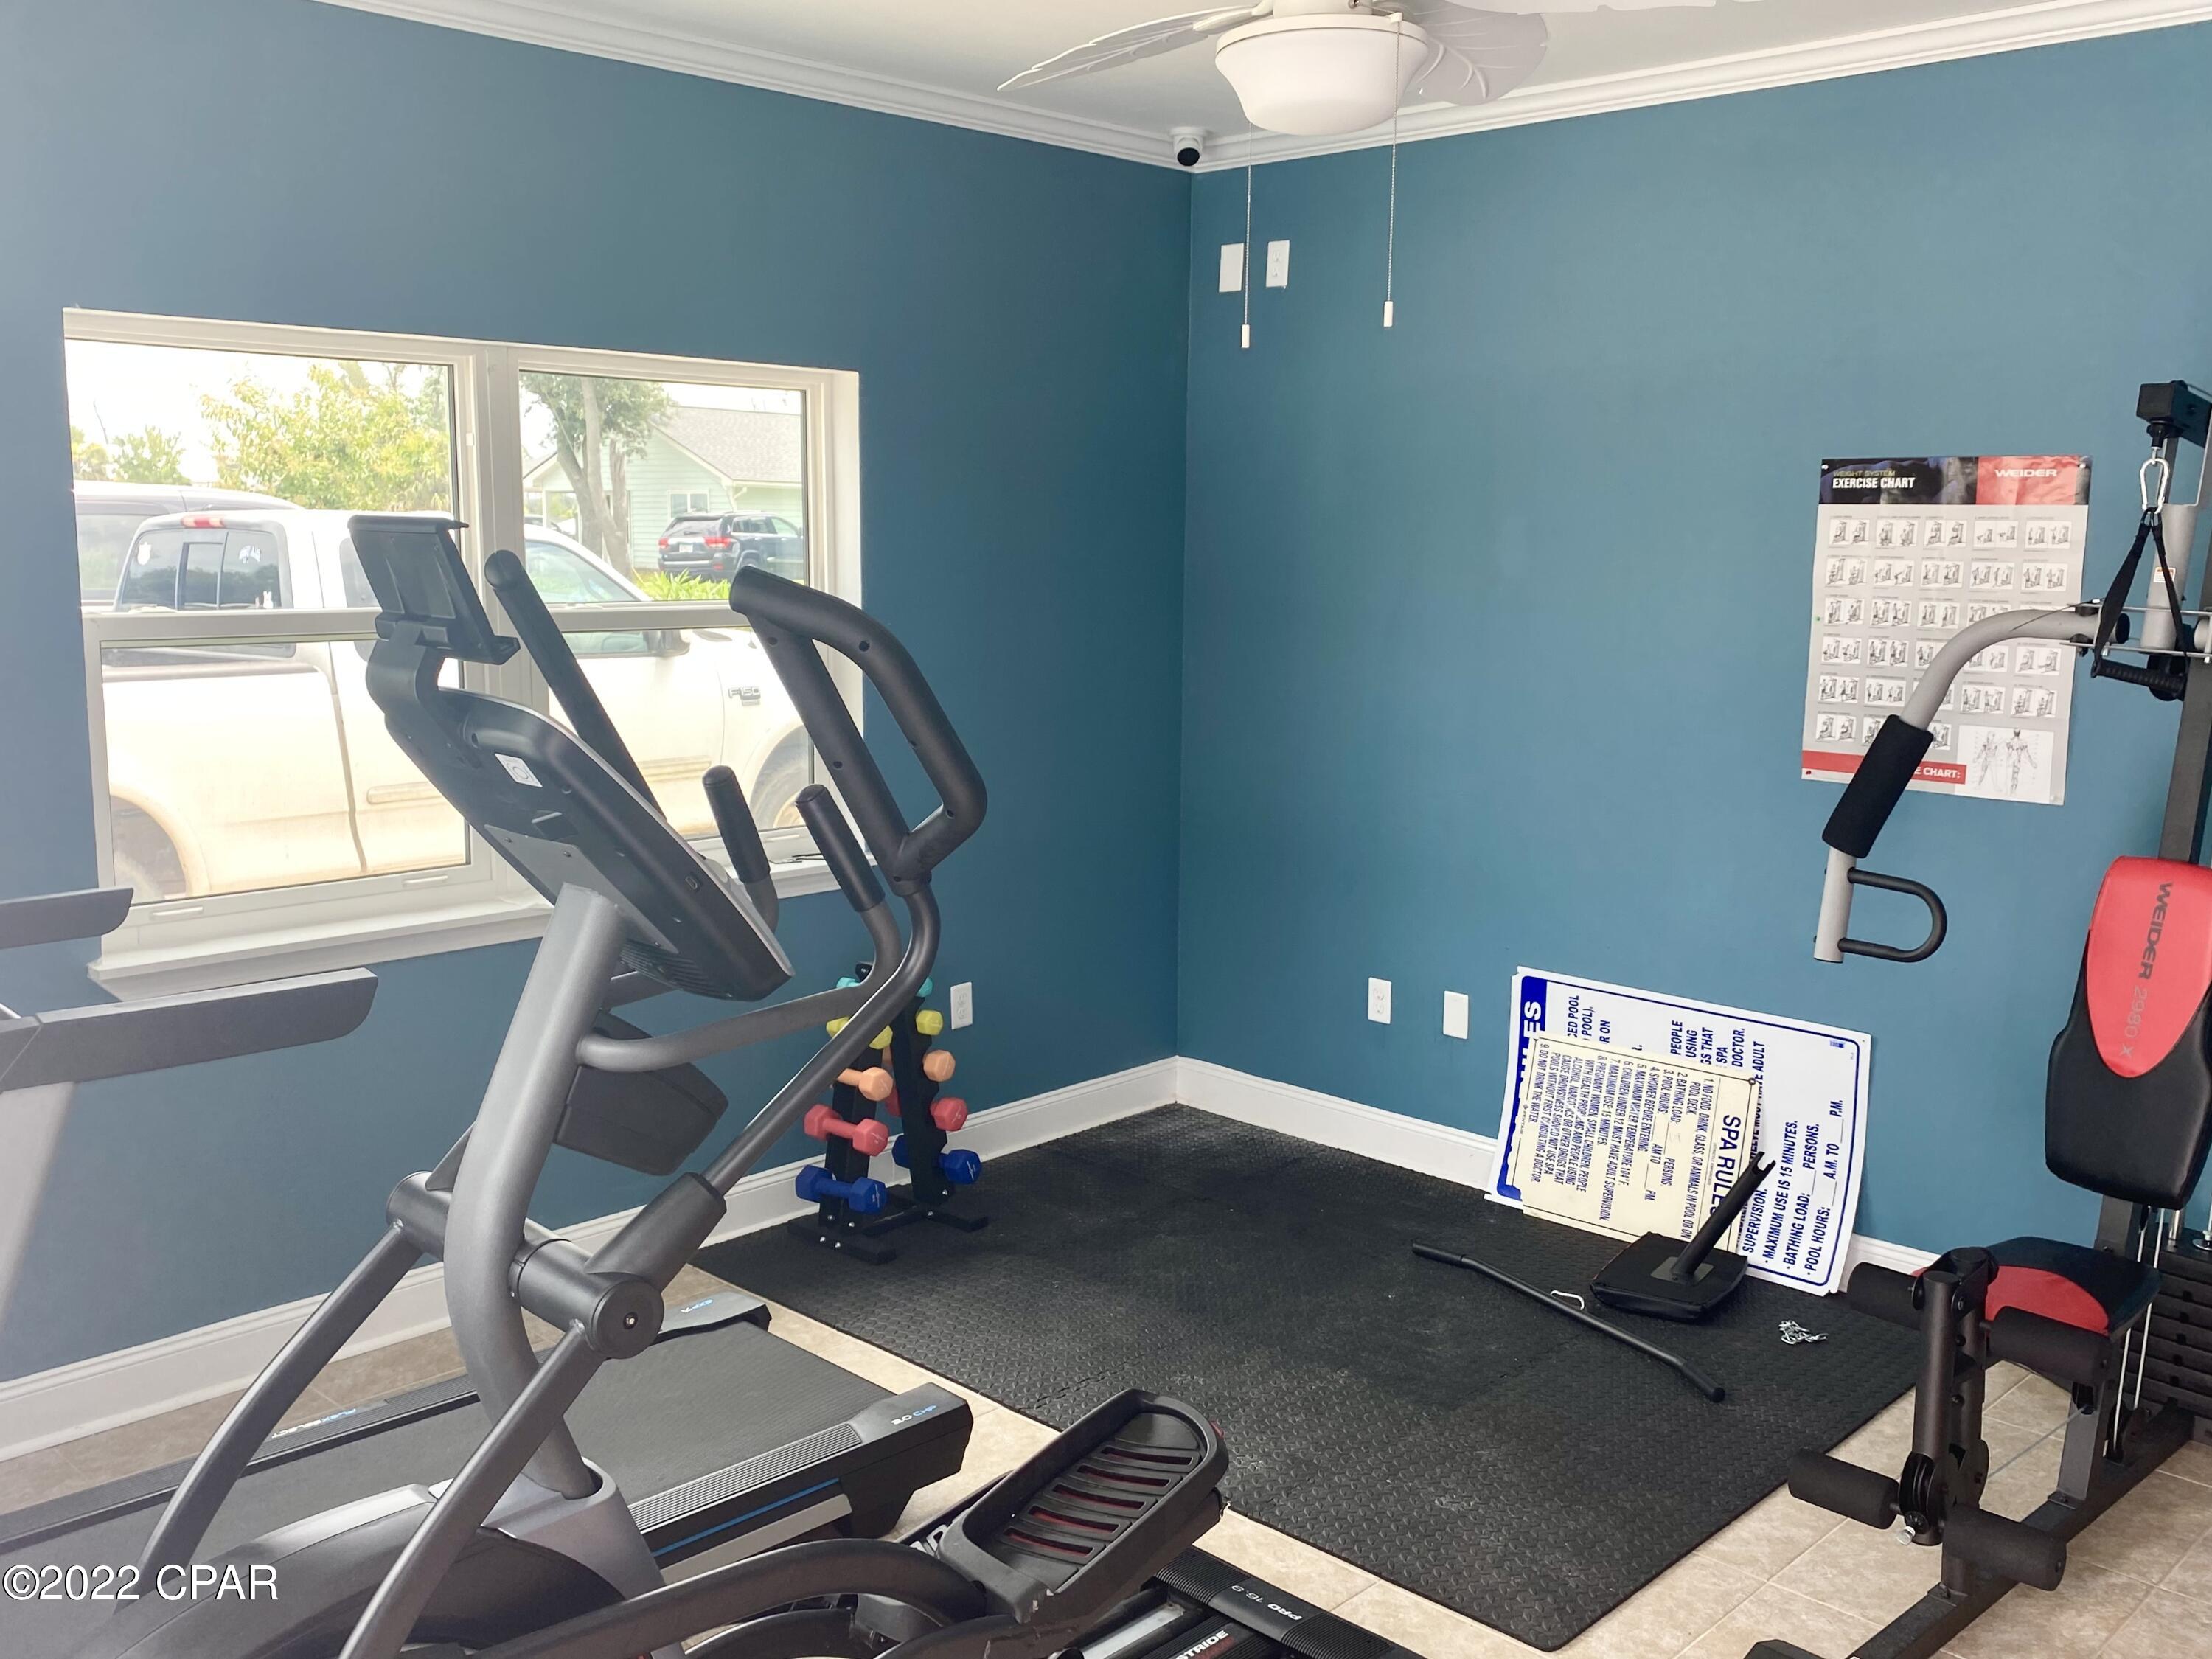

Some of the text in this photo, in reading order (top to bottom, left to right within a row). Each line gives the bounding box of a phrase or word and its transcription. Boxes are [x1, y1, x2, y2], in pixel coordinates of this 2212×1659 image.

[1832, 477, 1916, 489] EXERCISE CHART
[1994, 469, 2057, 477] WEIDER
[1923, 767, 1961, 779] CHART:
[2138, 883, 2172, 980] WEIDER
[1568, 993, 1579, 1019] POOL
[2124, 986, 2149, 1038] 2980
[1599, 1020, 1610, 1034] ON
[1669, 1020, 1682, 1054] PEOPLE
[1685, 1029, 1697, 1058] USING
[1701, 1026, 1714, 1051] THAT
[1731, 1026, 1745, 1067] DOCTOR.
[1538, 1049, 1548, 1058] DO
[1548, 1051, 1560, 1071] POOLS
[1715, 1045, 1728, 1064] SPA
[1752, 1040, 1765, 1071] ADULT
[1536, 1059, 1547, 1071] NOT
[1559, 1054, 1571, 1074] CAUSE
[1582, 1059, 1594, 1075] WITH
[1533, 1071, 1545, 1090] DRINK
[1544, 1071, 1557, 1099] WITHOUT
[1579, 1075, 1592, 1099] HEALTH
[1592, 1061, 1606, 1093] PREGNANT
[1604, 1064, 1619, 1096] MAXIMUM
[1618, 1067, 1632, 1096] CHILDREN
[1631, 1070, 1646, 1102] MAXIMUM
[1645, 1073, 1659, 1099] SHOWER
[1660, 1075, 1672, 1091] POOL
[1531, 1090, 1542, 1102] THE
[1672, 1078, 1687, 1105] BATHING
[1688, 1081, 1700, 1098] POOL
[1702, 1084, 1714, 1093] NO
[1541, 1099, 1553, 1116] FIRST
[1601, 1109, 1612, 1118] 15
[1615, 1096, 1628, 1117] UNDER
[1641, 1099, 1655, 1122] BEFORE
[1562, 1119, 1573, 1127] OR
[1613, 1117, 1624, 1125] 12
[1559, 1127, 1571, 1147] OTHER
[1571, 1130, 1583, 1144] AND
[1610, 1124, 1623, 1144] MUST
[1719, 1113, 1742, 1152] SPA
[1547, 1137, 1558, 1150] NOT
[1608, 1144, 1620, 1160] HAVE
[1621, 1123, 1638, 1166] TEMPERATURE
[1545, 1150, 1557, 1162] USE
[1556, 1147, 1568, 1168] DRUGS
[1568, 1144, 1581, 1166] PEOPLE
[1649, 1155, 1660, 1164] TO
[1691, 1156, 1703, 1166] OR
[1543, 1162, 1554, 1175] SPA
[1554, 1168, 1565, 1185] THAT
[1565, 1166, 1577, 1186] USING
[1605, 1160, 1618, 1180] ADULT
[1576, 1169, 1589, 1192] PEOPLE
[1687, 1165, 1701, 1194] ANIMALS
[1762, 1119, 1798, 1259] MAXIMUM USE IS 15 MINUTES.
[1804, 1097, 1843, 1271] POOL HOURS: A.M. TO P.M.
[1686, 1194, 1697, 1202] IN
[1783, 1121, 1819, 1265] BATHING LOAD: PERSONS.
[1683, 1202, 1696, 1219] POOL
[1742, 1186, 1767, 1253] SUPERVISION.
[1682, 1218, 1693, 1228] OR
[1680, 1228, 1692, 1239] ON
[1231, 1585, 1302, 1620] PRO 16.9
